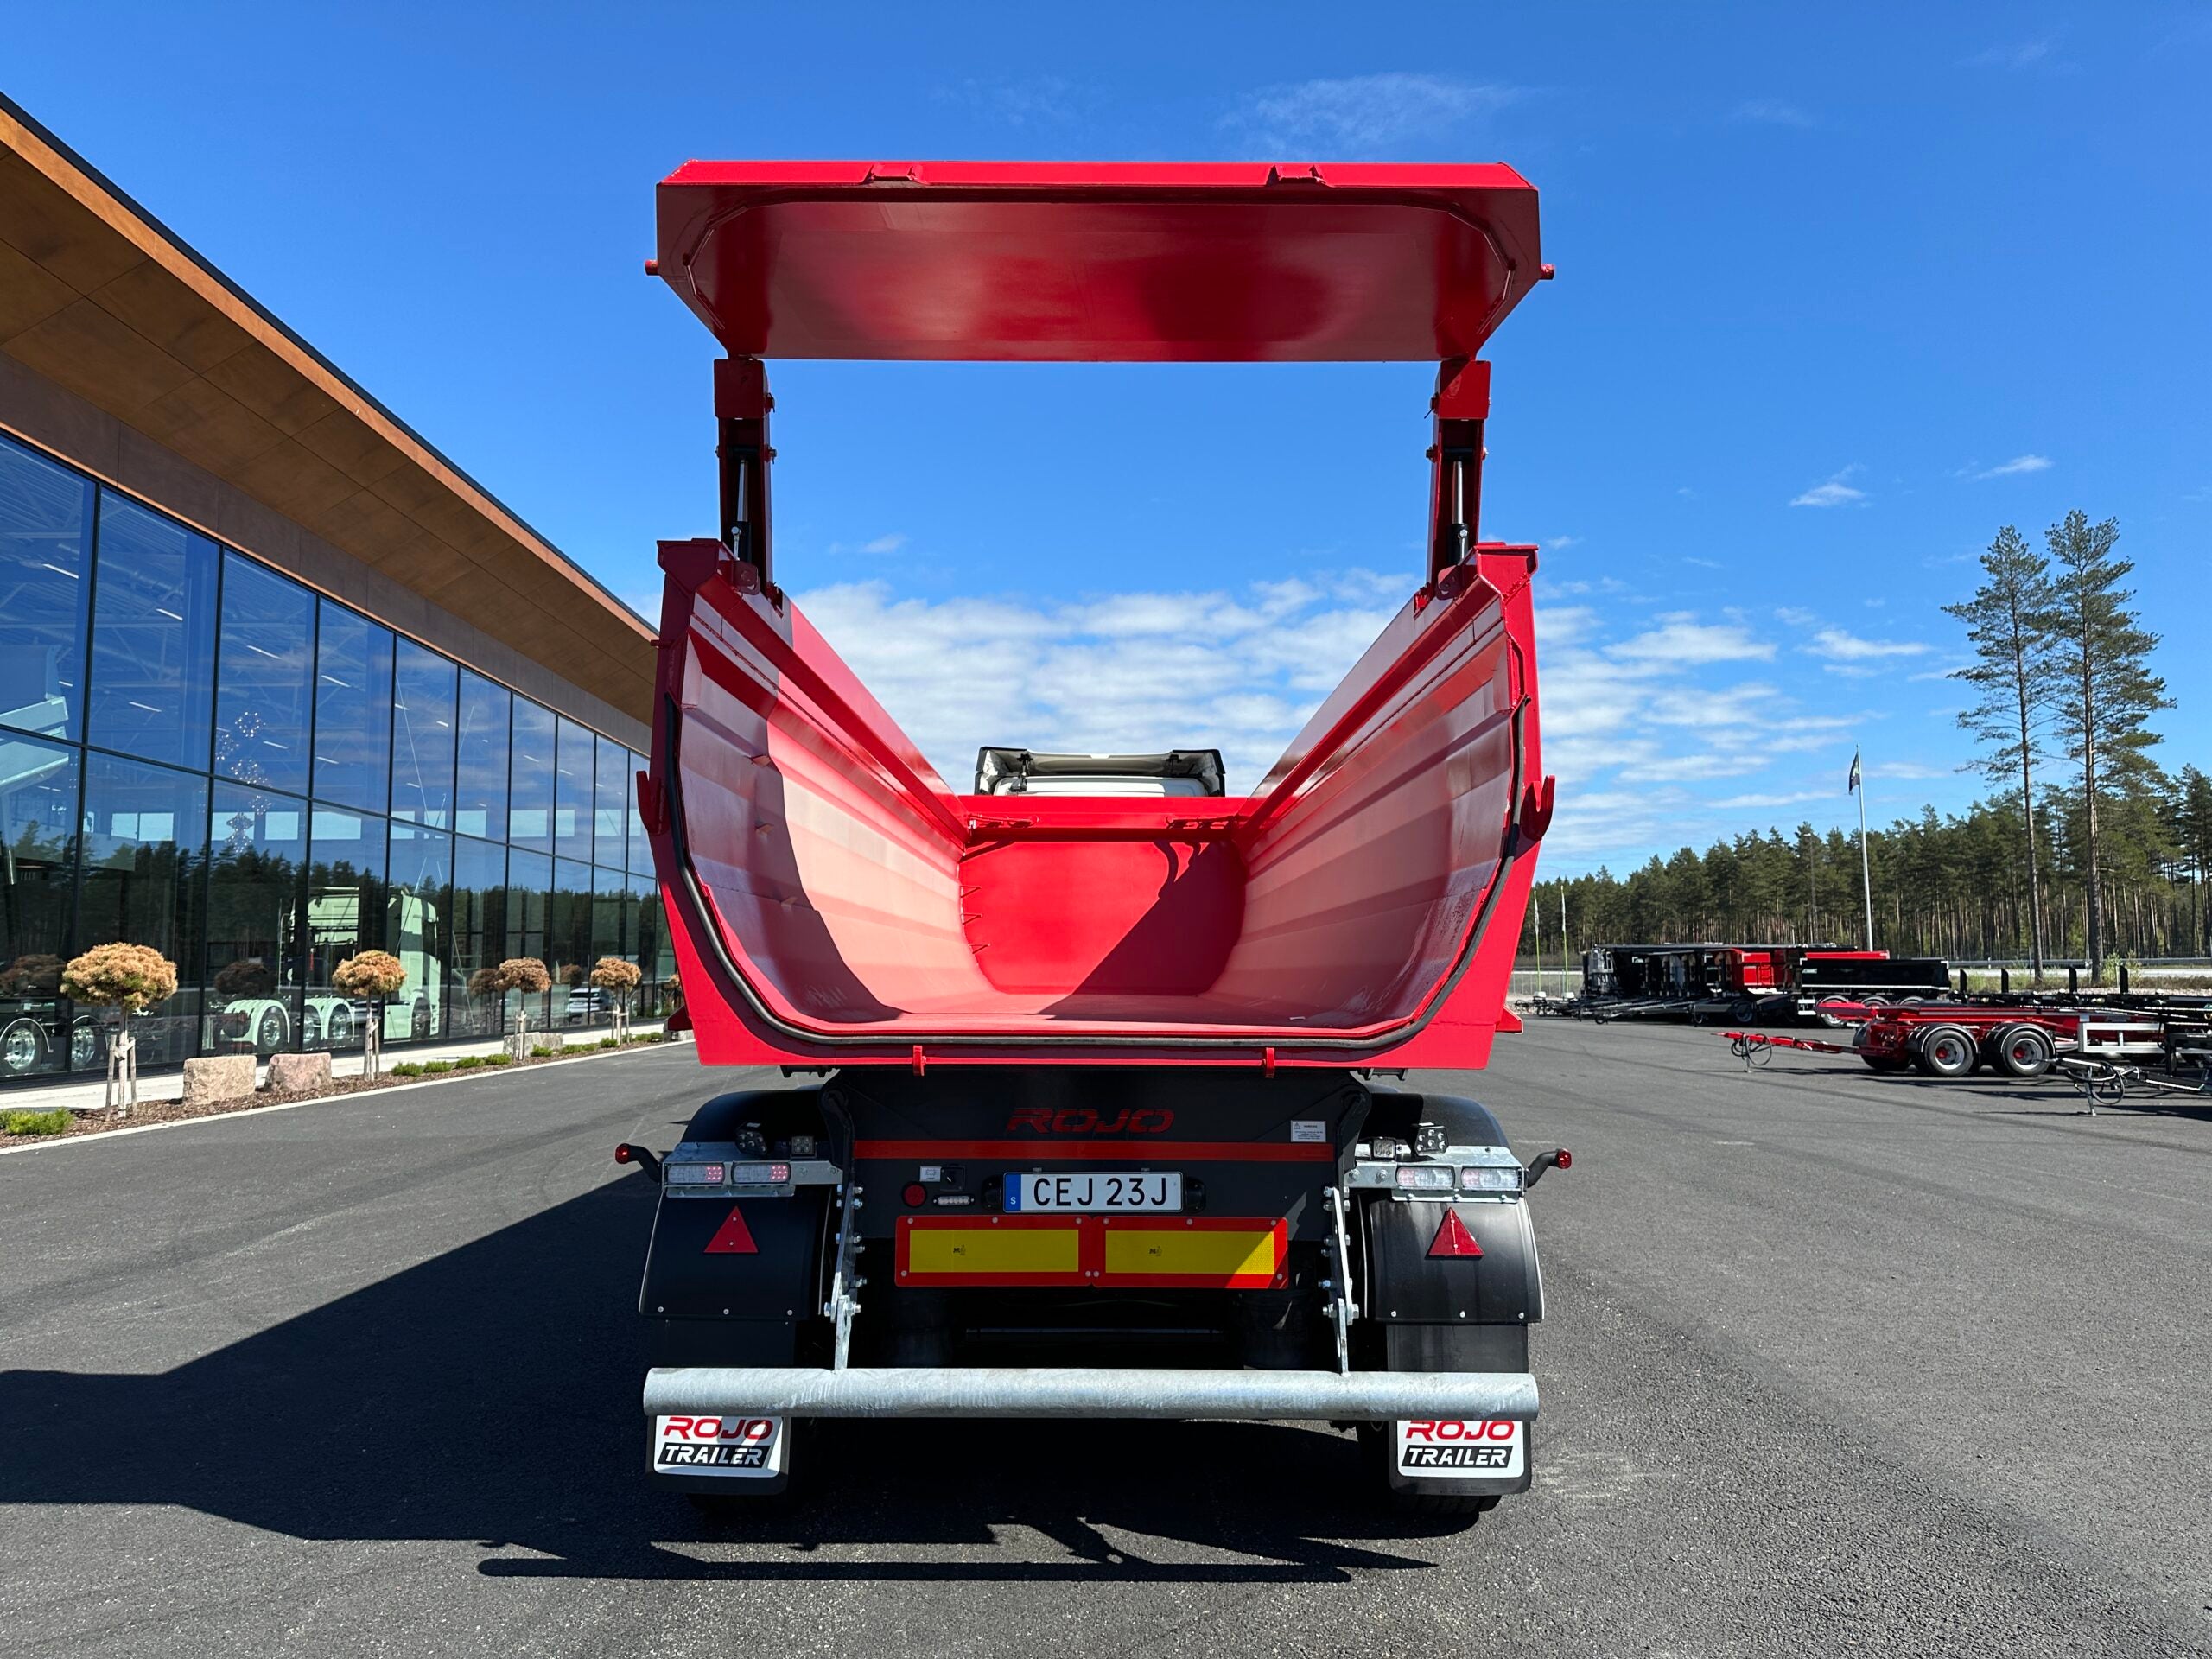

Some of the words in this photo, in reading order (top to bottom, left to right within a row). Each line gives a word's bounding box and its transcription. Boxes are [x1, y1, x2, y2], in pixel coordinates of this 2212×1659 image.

[1006, 1108, 1175, 1134] ROJO
[1010, 1196, 1016, 1205] S
[1033, 1178, 1092, 1206] CEJ
[1106, 1178, 1166, 1206] 23J
[664, 1417, 773, 1440] ROJO
[1406, 1421, 1515, 1441] ROJO
[665, 1445, 763, 1465] TRAILER
[1408, 1448, 1507, 1465] TRAILER
